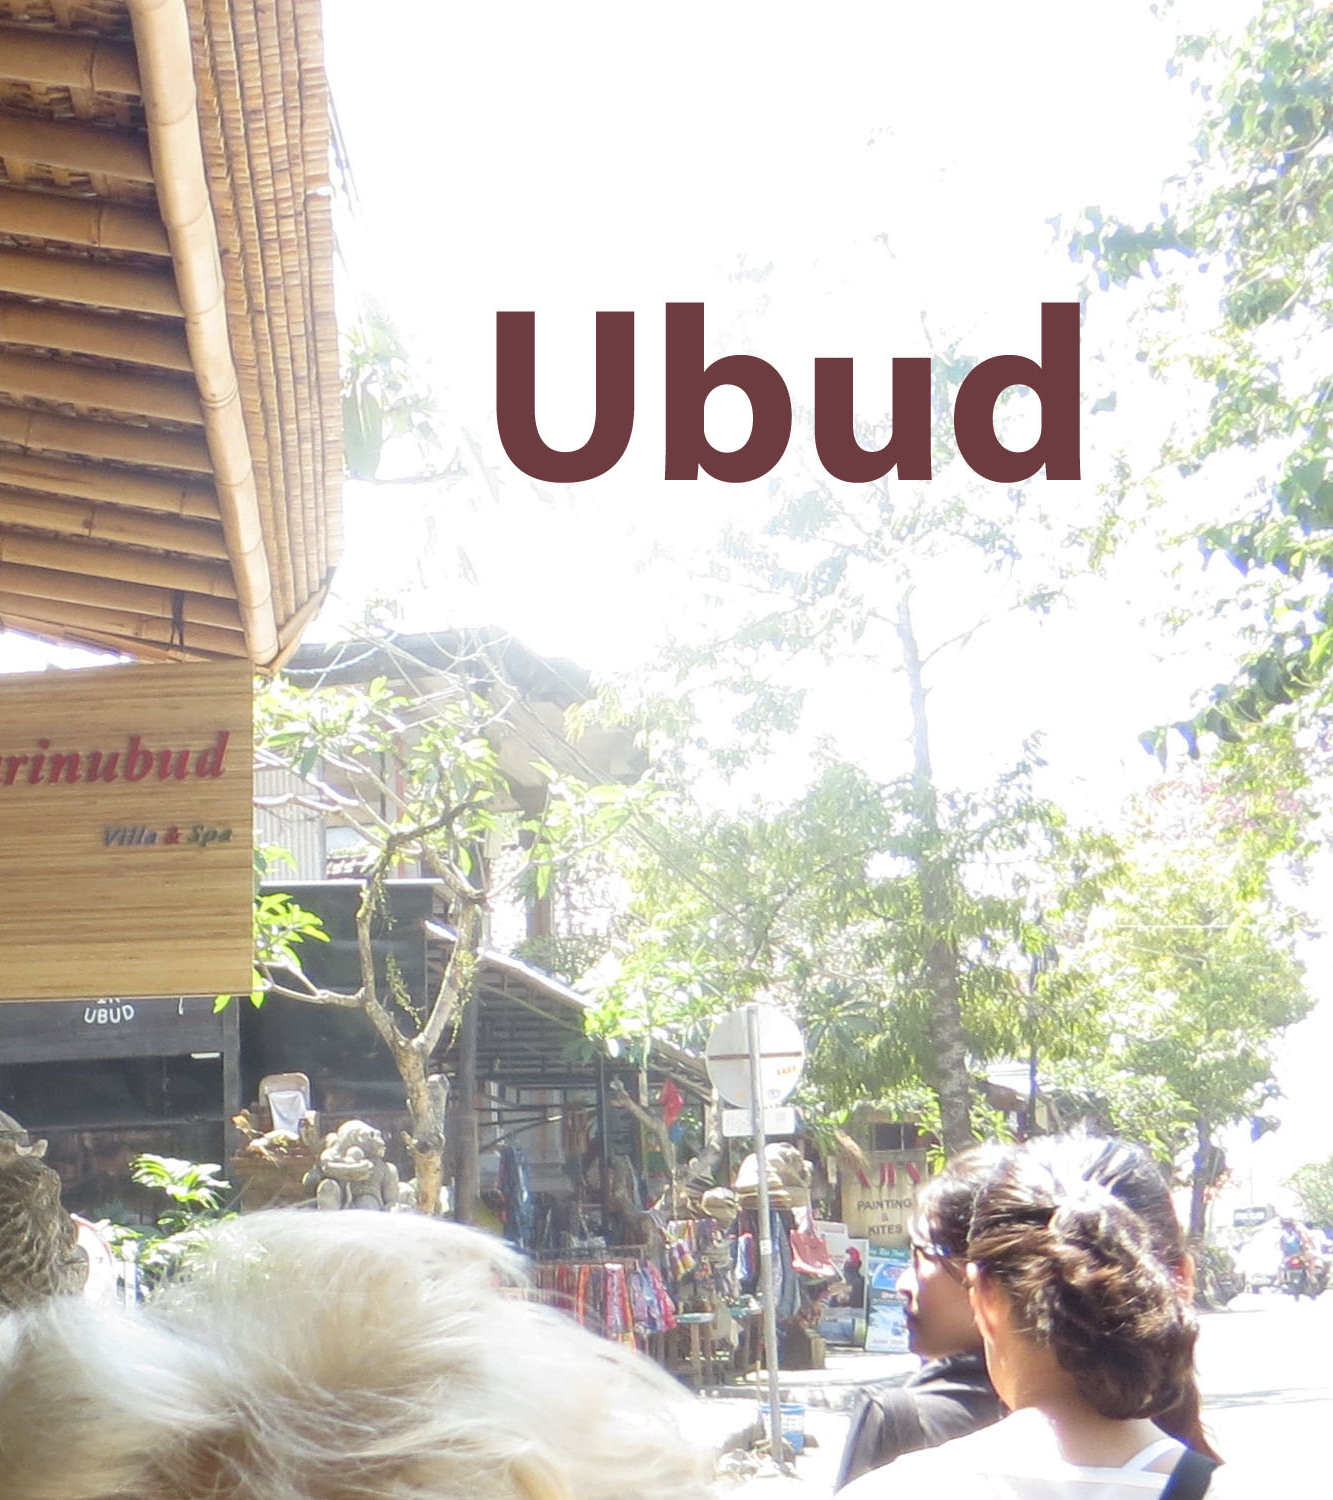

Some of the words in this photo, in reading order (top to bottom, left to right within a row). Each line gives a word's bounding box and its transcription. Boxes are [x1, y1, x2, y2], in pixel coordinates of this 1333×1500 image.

[104, 826, 159, 847] Villa
[164, 825, 180, 845] &
[187, 823, 233, 848] Spa
[84, 1004, 135, 1024] UBUD
[857, 1199, 913, 1212] PAINTING
[868, 1223, 904, 1236] KITES
